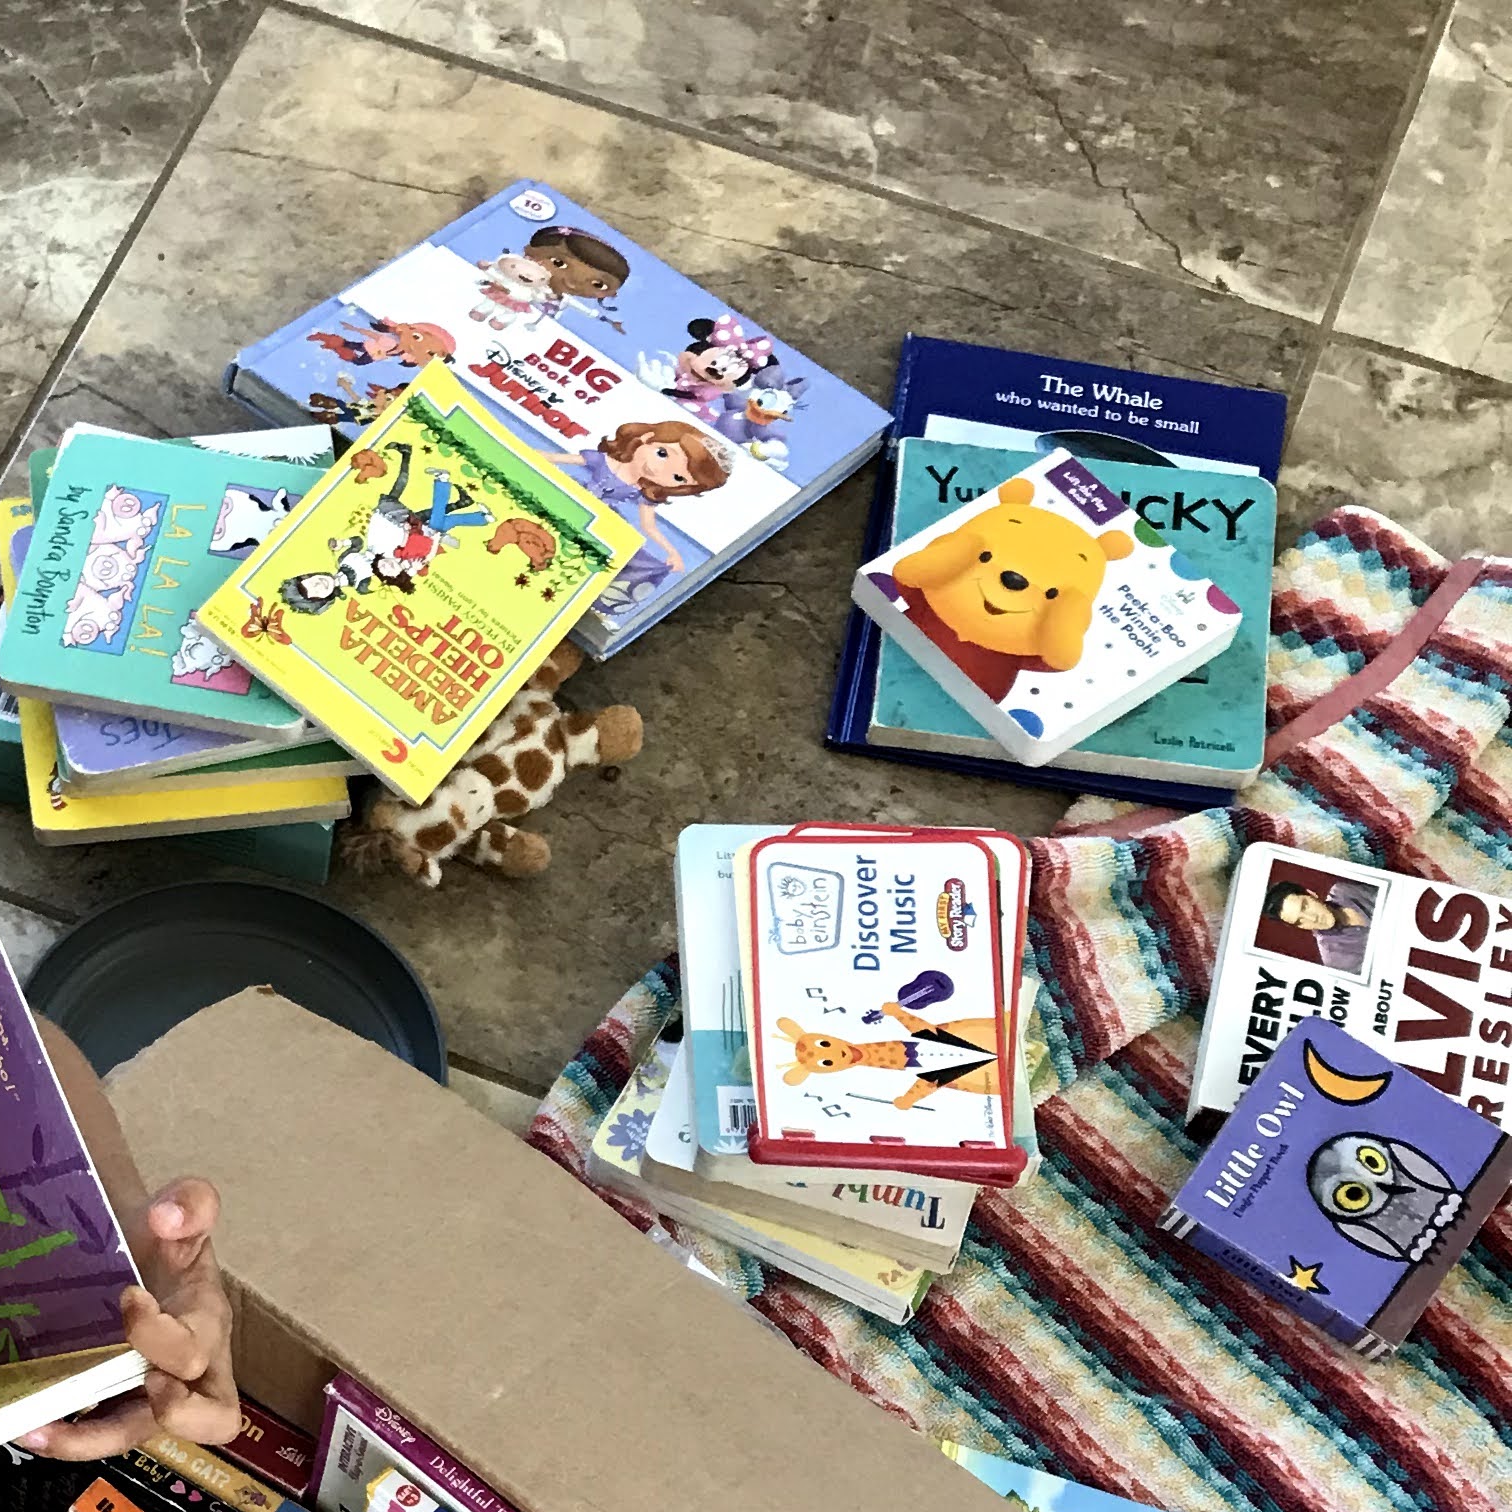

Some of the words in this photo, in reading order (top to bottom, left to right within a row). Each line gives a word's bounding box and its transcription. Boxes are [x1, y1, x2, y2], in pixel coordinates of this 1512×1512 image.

[524, 353, 571, 388] Book
[574, 390, 601, 404] of
[543, 338, 623, 393] BIG
[1040, 374, 1083, 398] The
[1092, 383, 1163, 411] Whale
[468, 361, 591, 439] Junior
[995, 392, 1032, 407] who
[1038, 398, 1099, 418] wanted
[1105, 409, 1122, 422] to
[1128, 411, 1149, 425] be
[1154, 420, 1199, 434] small
[55, 484, 93, 503] by
[163, 503, 208, 538] LA
[44, 507, 89, 562] Sandra
[152, 556, 190, 590] LA
[423, 578, 462, 612] PARISH
[21, 568, 72, 635] Boynton
[462, 610, 499, 641] PEGGY
[1117, 584, 1186, 648] Peek-a-Boo
[1119, 603, 1161, 643] Winnie
[345, 597, 475, 712] BEDELIA
[388, 604, 492, 692] HELPS
[437, 614, 505, 669] OUT
[498, 637, 516, 654] BY
[1099, 605, 1120, 624] the
[1120, 623, 1160, 658] Pooh!
[339, 625, 458, 725] AMELIA
[785, 909, 813, 945] baby
[801, 877, 831, 943] einstein
[851, 854, 880, 971] Discover
[886, 874, 918, 953] Music
[950, 884, 963, 918] Reader
[951, 919, 967, 948] Story
[1372, 979, 1394, 1036] ABOUT
[1394, 886, 1490, 1096] LVIS
[1238, 966, 1288, 1087] EVERY
[1204, 1143, 1265, 1208] Little
[1256, 1081, 1305, 1138] Owl
[135, 1456, 170, 1483] Baby!
[159, 1438, 187, 1463] the
[191, 1457, 232, 1488] CAT?
[429, 1455, 496, 1510] Delightful
